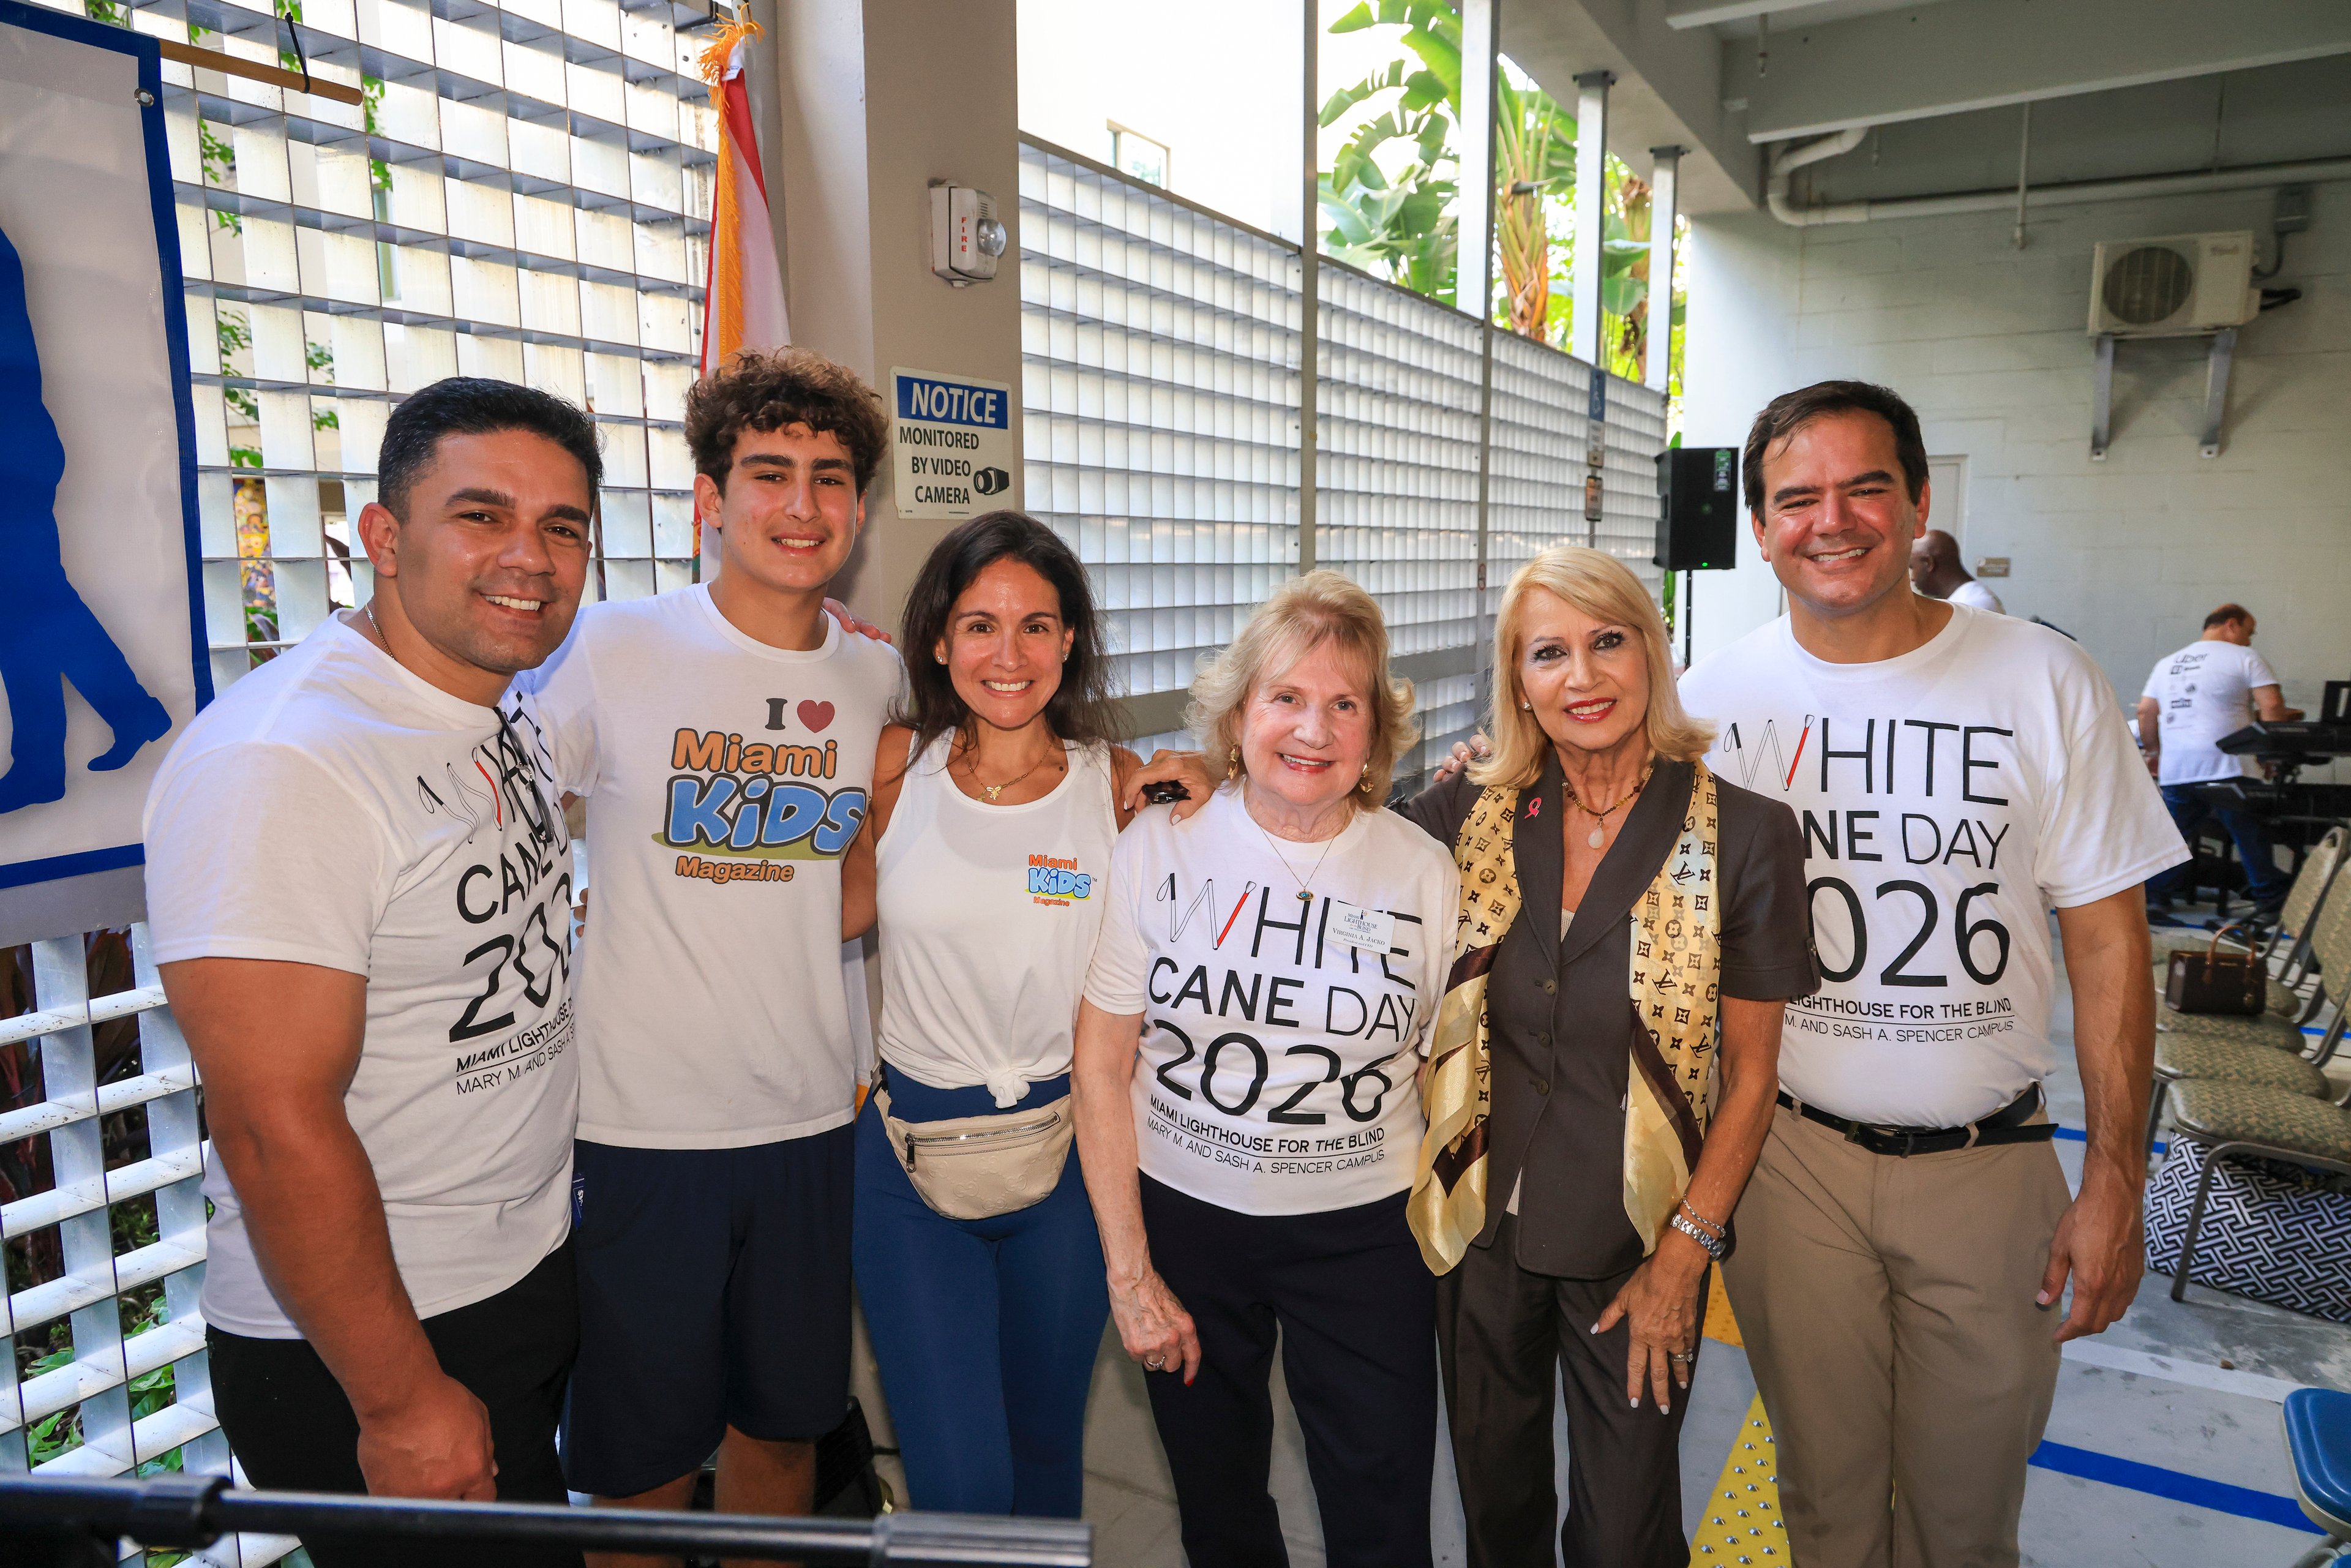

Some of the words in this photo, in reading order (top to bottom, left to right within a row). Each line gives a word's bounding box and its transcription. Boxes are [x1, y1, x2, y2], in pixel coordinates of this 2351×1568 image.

[911, 382, 997, 424] NOTICE
[899, 426, 979, 449] MONITORED
[912, 456, 928, 474] BY
[931, 457, 971, 477] VIDEO
[915, 486, 970, 505] CAMERA
[765, 698, 787, 730] I
[671, 727, 838, 779] Miami
[1724, 715, 2014, 806] WHITE
[1803, 810, 1883, 862] NE
[1902, 813, 2010, 870] DAY
[675, 855, 795, 883] Magazine
[1029, 853, 1078, 871] Miami
[1033, 896, 1070, 907] Magazine
[1344, 915, 1378, 929] LIGHTHOUSE
[1333, 928, 1357, 939] VIRGINIA
[1367, 937, 1385, 945] JACKO
[1807, 876, 2011, 987] 026
[449, 872, 571, 1043] 202
[1149, 956, 1305, 1028] CANE
[1325, 986, 1415, 1042] DAY
[1900, 1004, 1935, 1019] FOR
[1940, 1003, 1973, 1019] THE
[1976, 997, 2012, 1016] BLIND
[456, 1042, 505, 1073] MIAMI
[509, 1002, 569, 1054] LIGHTHOUSE
[1785, 1013, 1797, 1028] M.
[1801, 1018, 1828, 1034] AND
[1833, 1024, 1872, 1040] SASH
[1878, 1029, 1892, 1041] A.
[1897, 1029, 1963, 1042] SPENCER
[1967, 1021, 2014, 1039] CAMPUS
[456, 1070, 502, 1095] MARY
[524, 1051, 546, 1075] AND
[547, 1035, 566, 1060] SASH
[1153, 1019, 1398, 1125] 2026
[1150, 1093, 1178, 1123] MIAMI
[1180, 1113, 1273, 1152] LIGHTHOUSE
[1278, 1139, 1310, 1153] FOR
[1316, 1138, 1345, 1152] THE
[1348, 1127, 1385, 1148] BLIND
[1147, 1116, 1172, 1139] MARY
[1173, 1132, 1183, 1147] M.
[1186, 1140, 1212, 1158] AND
[1215, 1150, 1250, 1171] SASH
[1253, 1162, 1265, 1174] A.
[1270, 1161, 1332, 1174] SPENCER
[1337, 1149, 1385, 1171] CAMPUS
